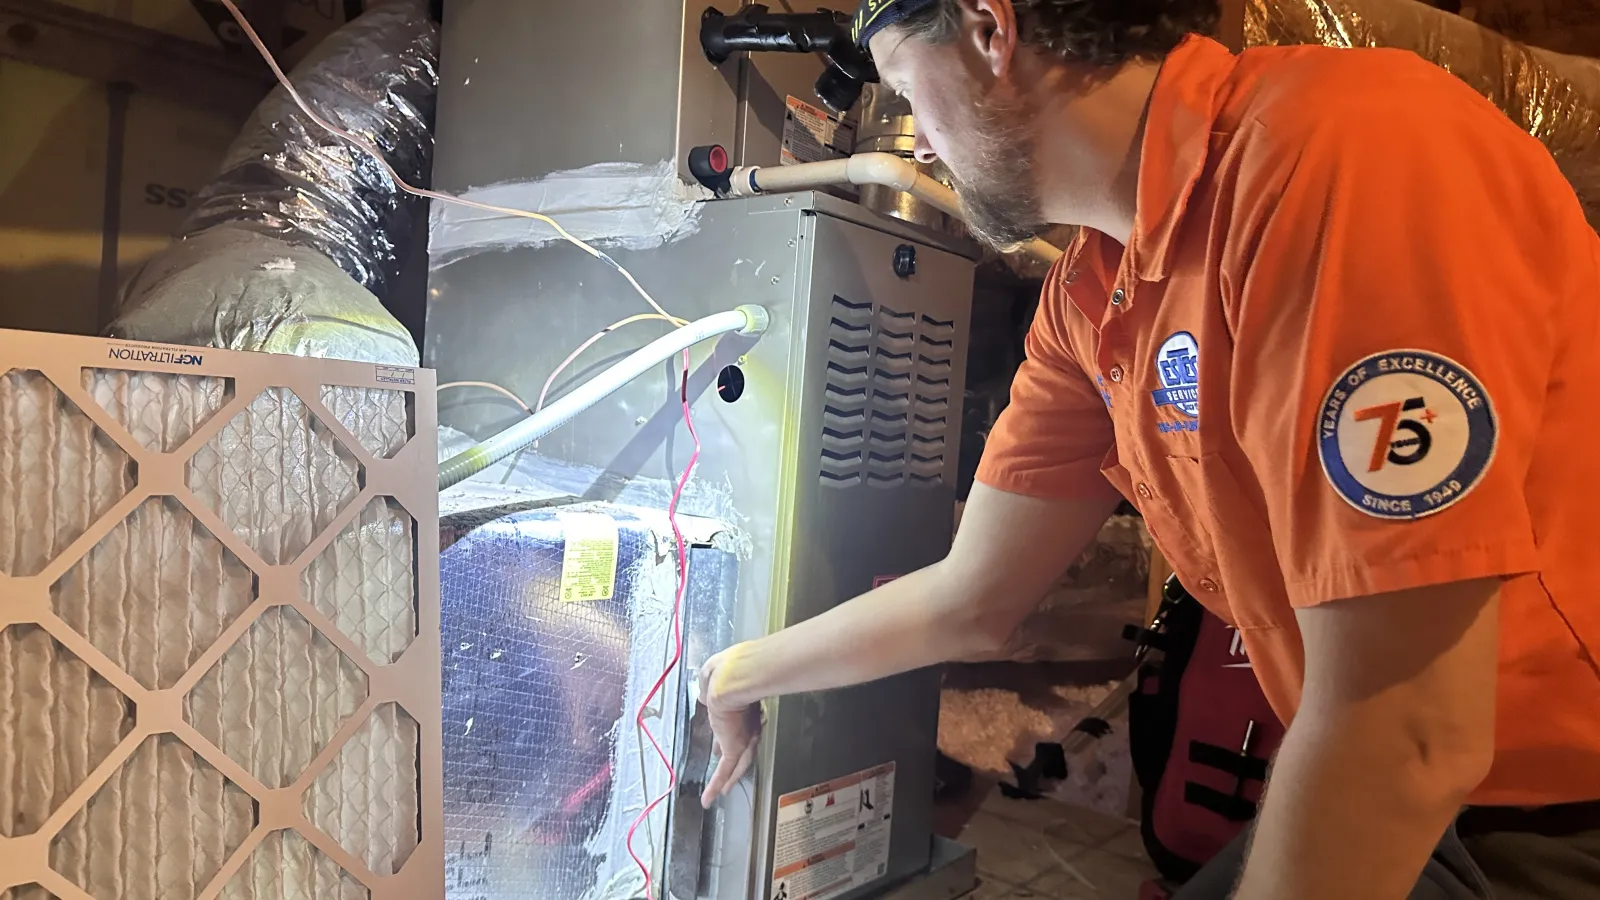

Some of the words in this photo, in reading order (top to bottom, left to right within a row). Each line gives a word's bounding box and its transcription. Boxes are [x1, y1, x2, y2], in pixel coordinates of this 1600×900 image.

[145, 183, 197, 208] SS
[1323, 389, 1347, 440] YEARS
[1347, 366, 1368, 387] OF
[1378, 357, 1481, 409] EXCELLENCE
[1362, 493, 1412, 512] SINCE
[1422, 479, 1462, 506] 1949
